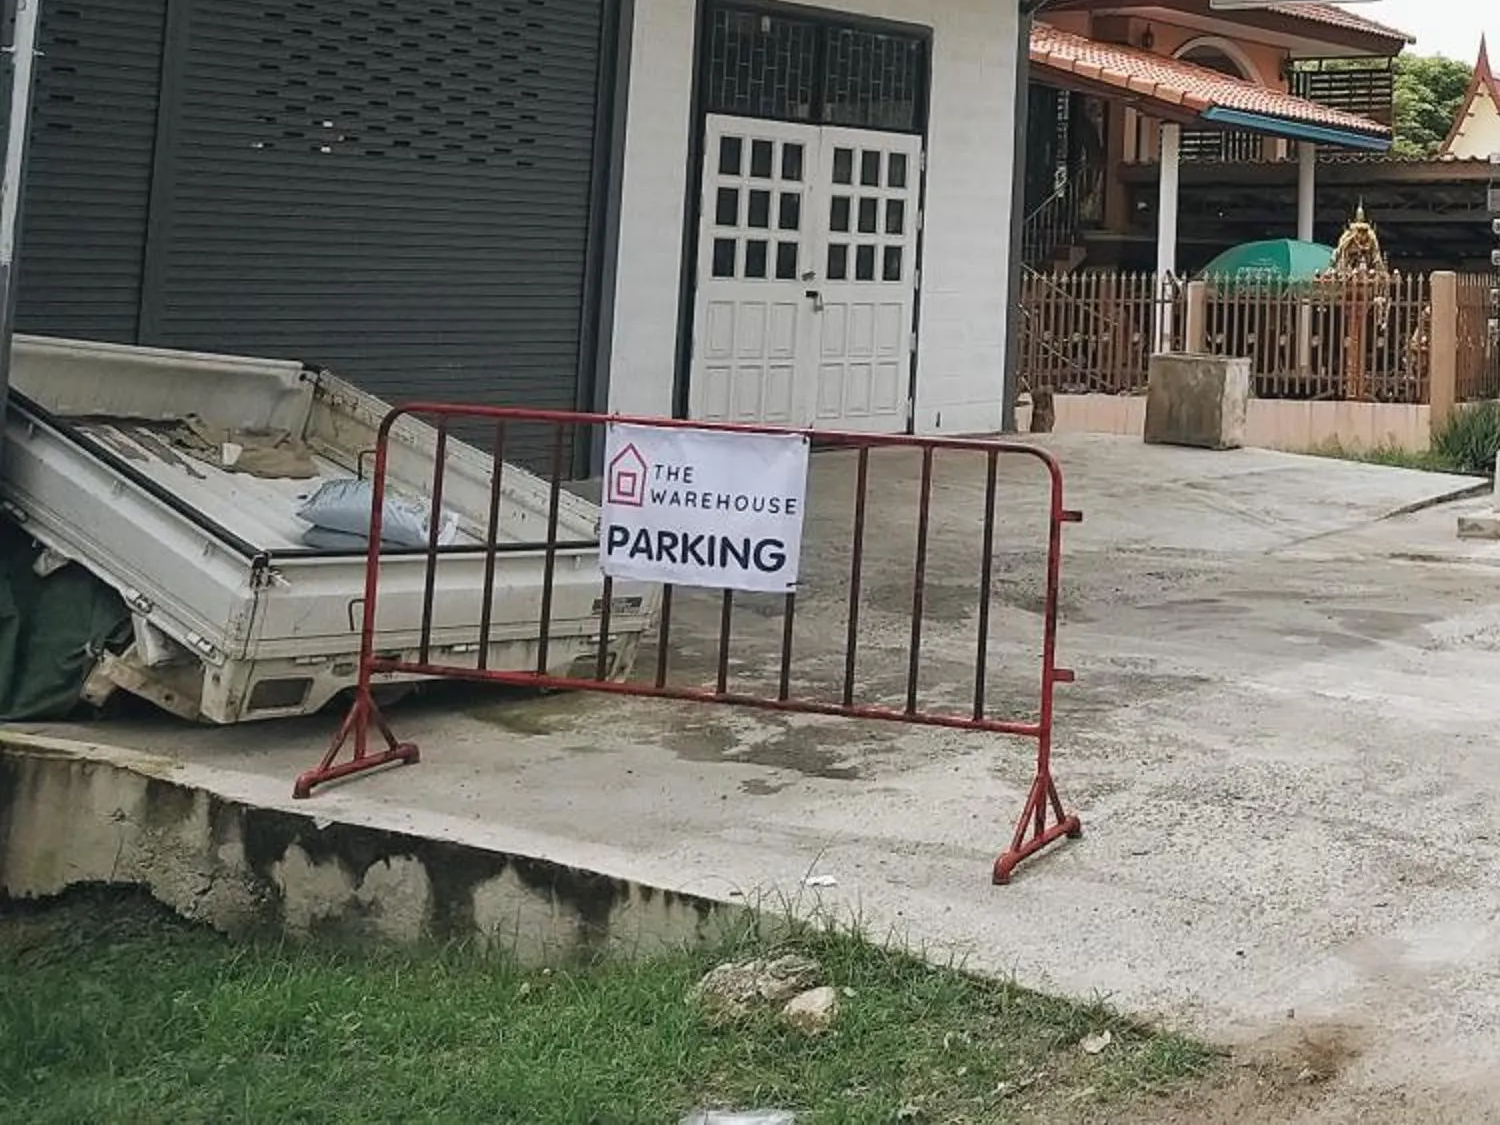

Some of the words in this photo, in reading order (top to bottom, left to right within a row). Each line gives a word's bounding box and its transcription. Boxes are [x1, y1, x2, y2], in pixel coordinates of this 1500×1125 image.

[654, 463, 694, 484] THE
[650, 488, 798, 516] WAREHOUSE
[607, 524, 787, 573] PARKING
